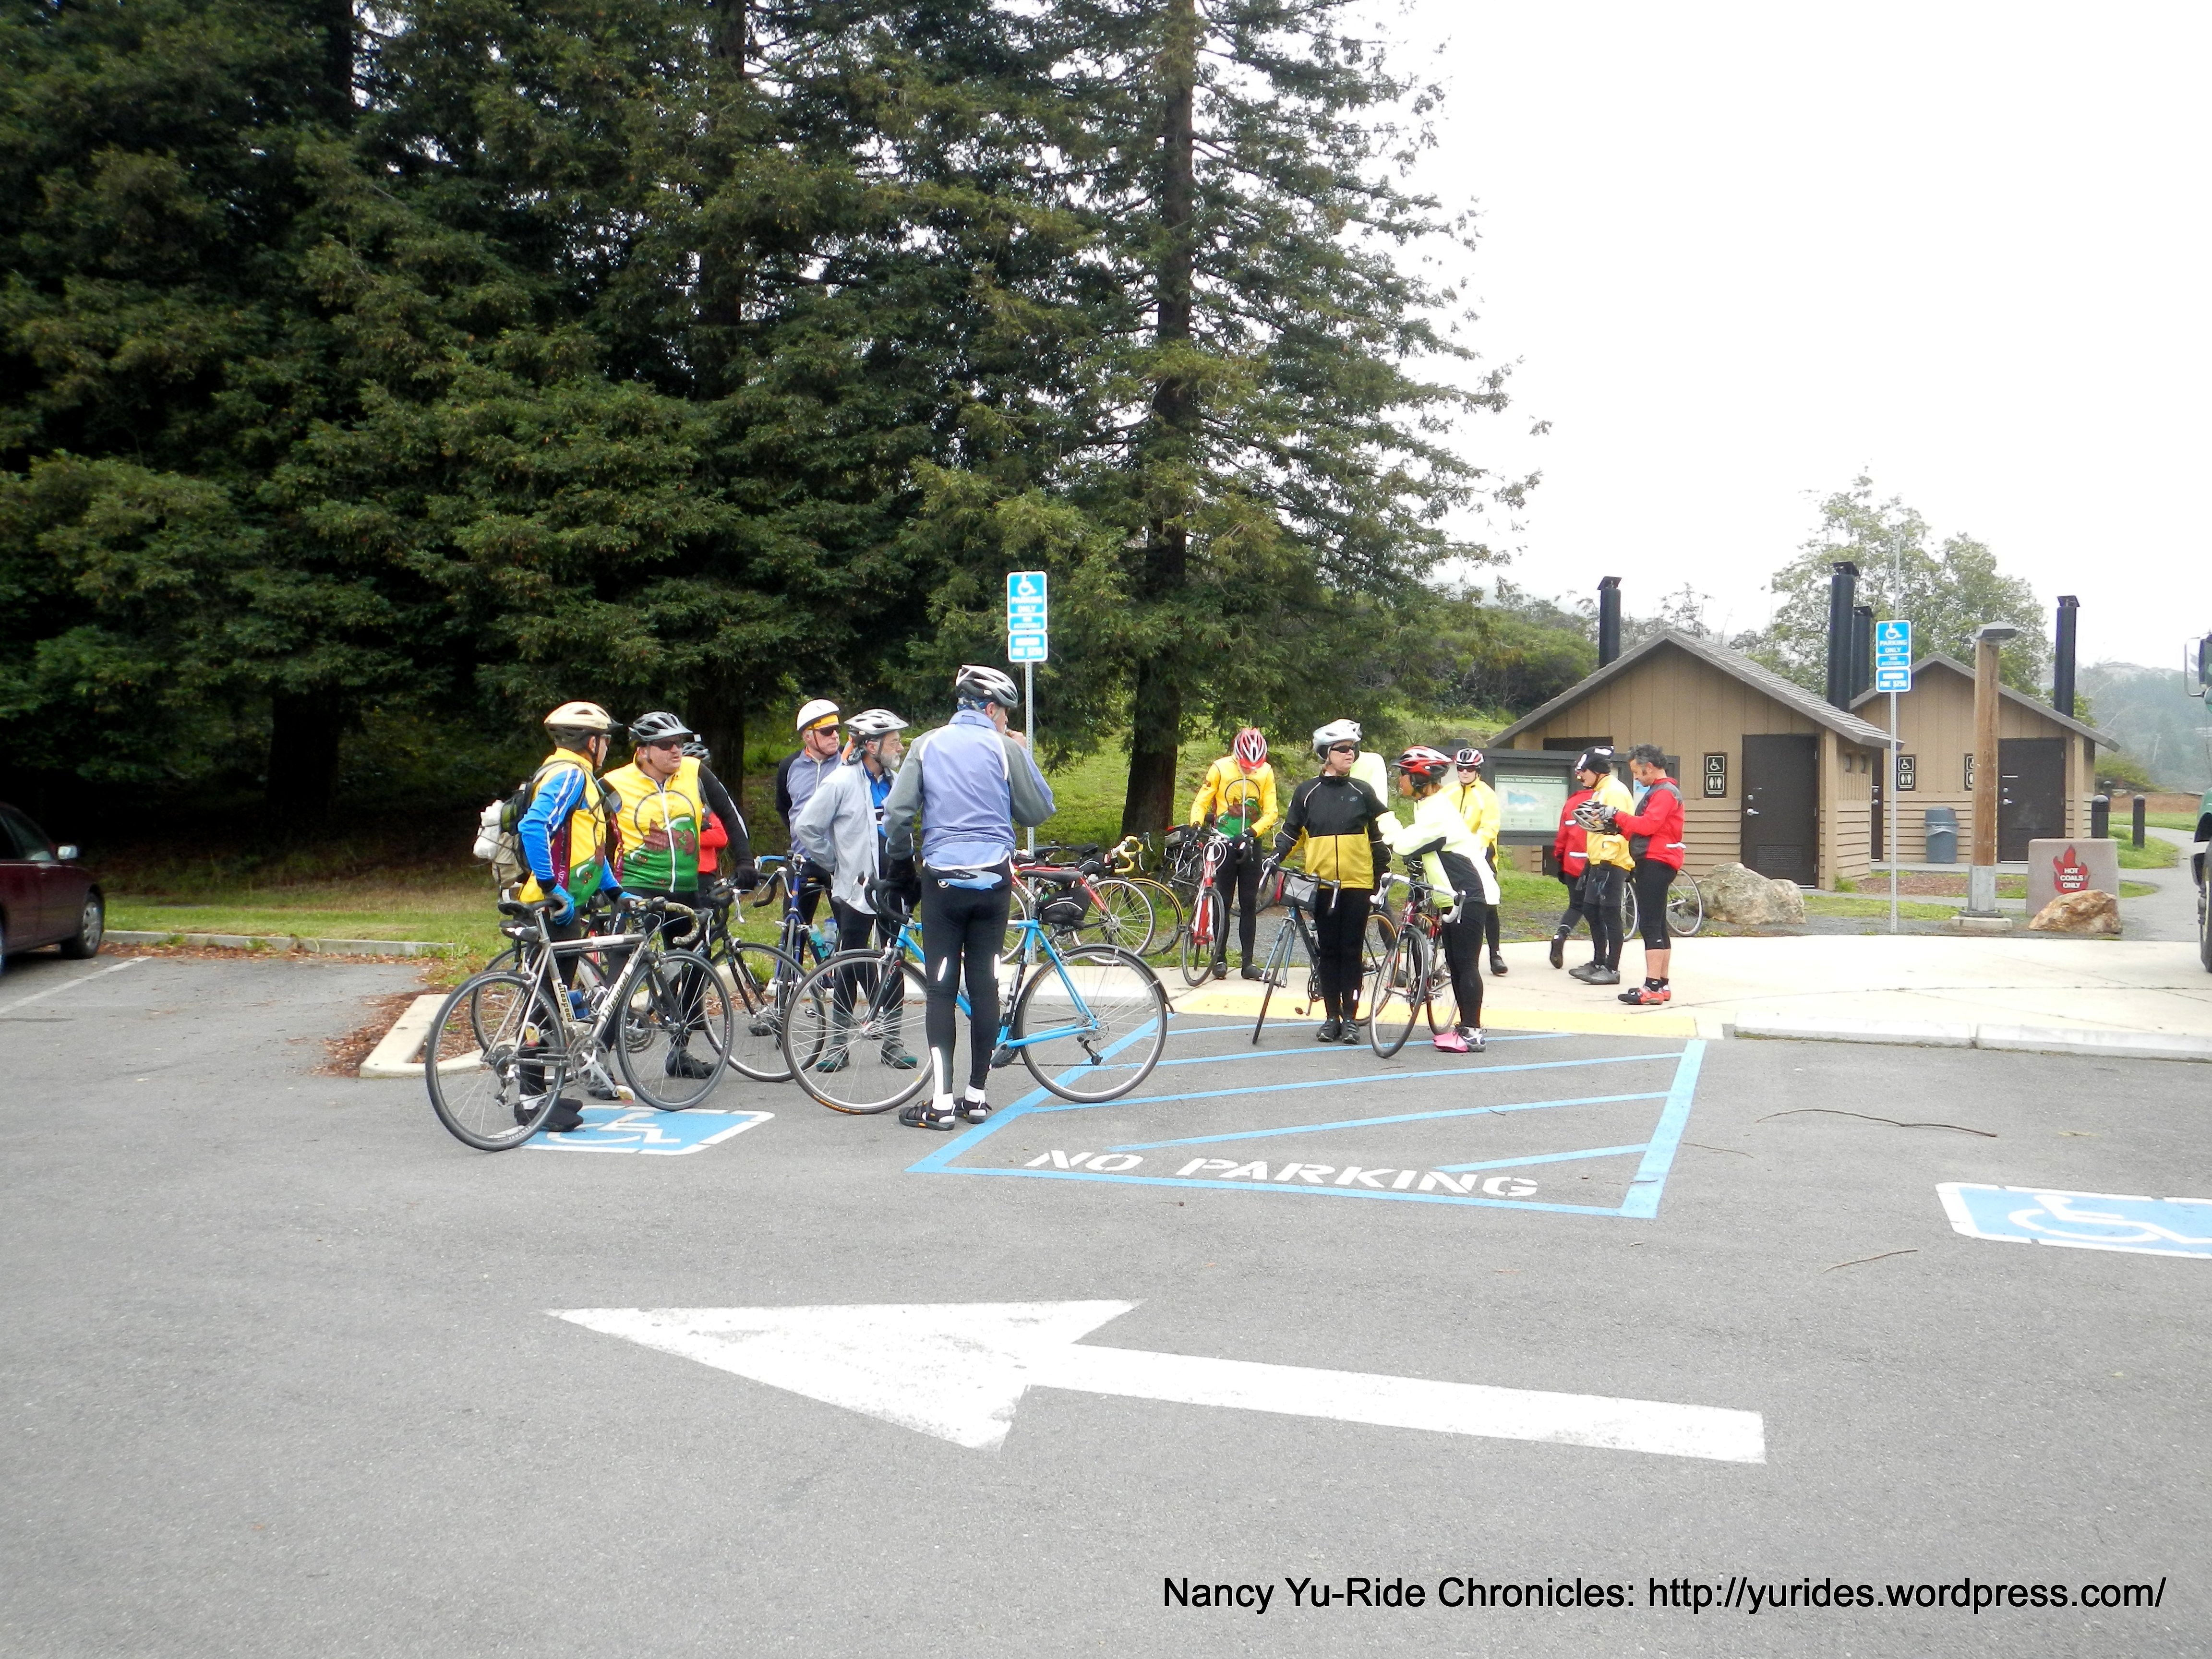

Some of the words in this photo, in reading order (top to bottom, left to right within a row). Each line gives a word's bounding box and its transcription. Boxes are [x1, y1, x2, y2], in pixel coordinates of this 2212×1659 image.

[1011, 596, 1043, 604] PARKING
[557, 982, 573, 1022] Litespeed
[601, 972, 630, 1019] Litespeed
[1024, 1150, 1144, 1171] NO
[1176, 1158, 1539, 1197] PARKING
